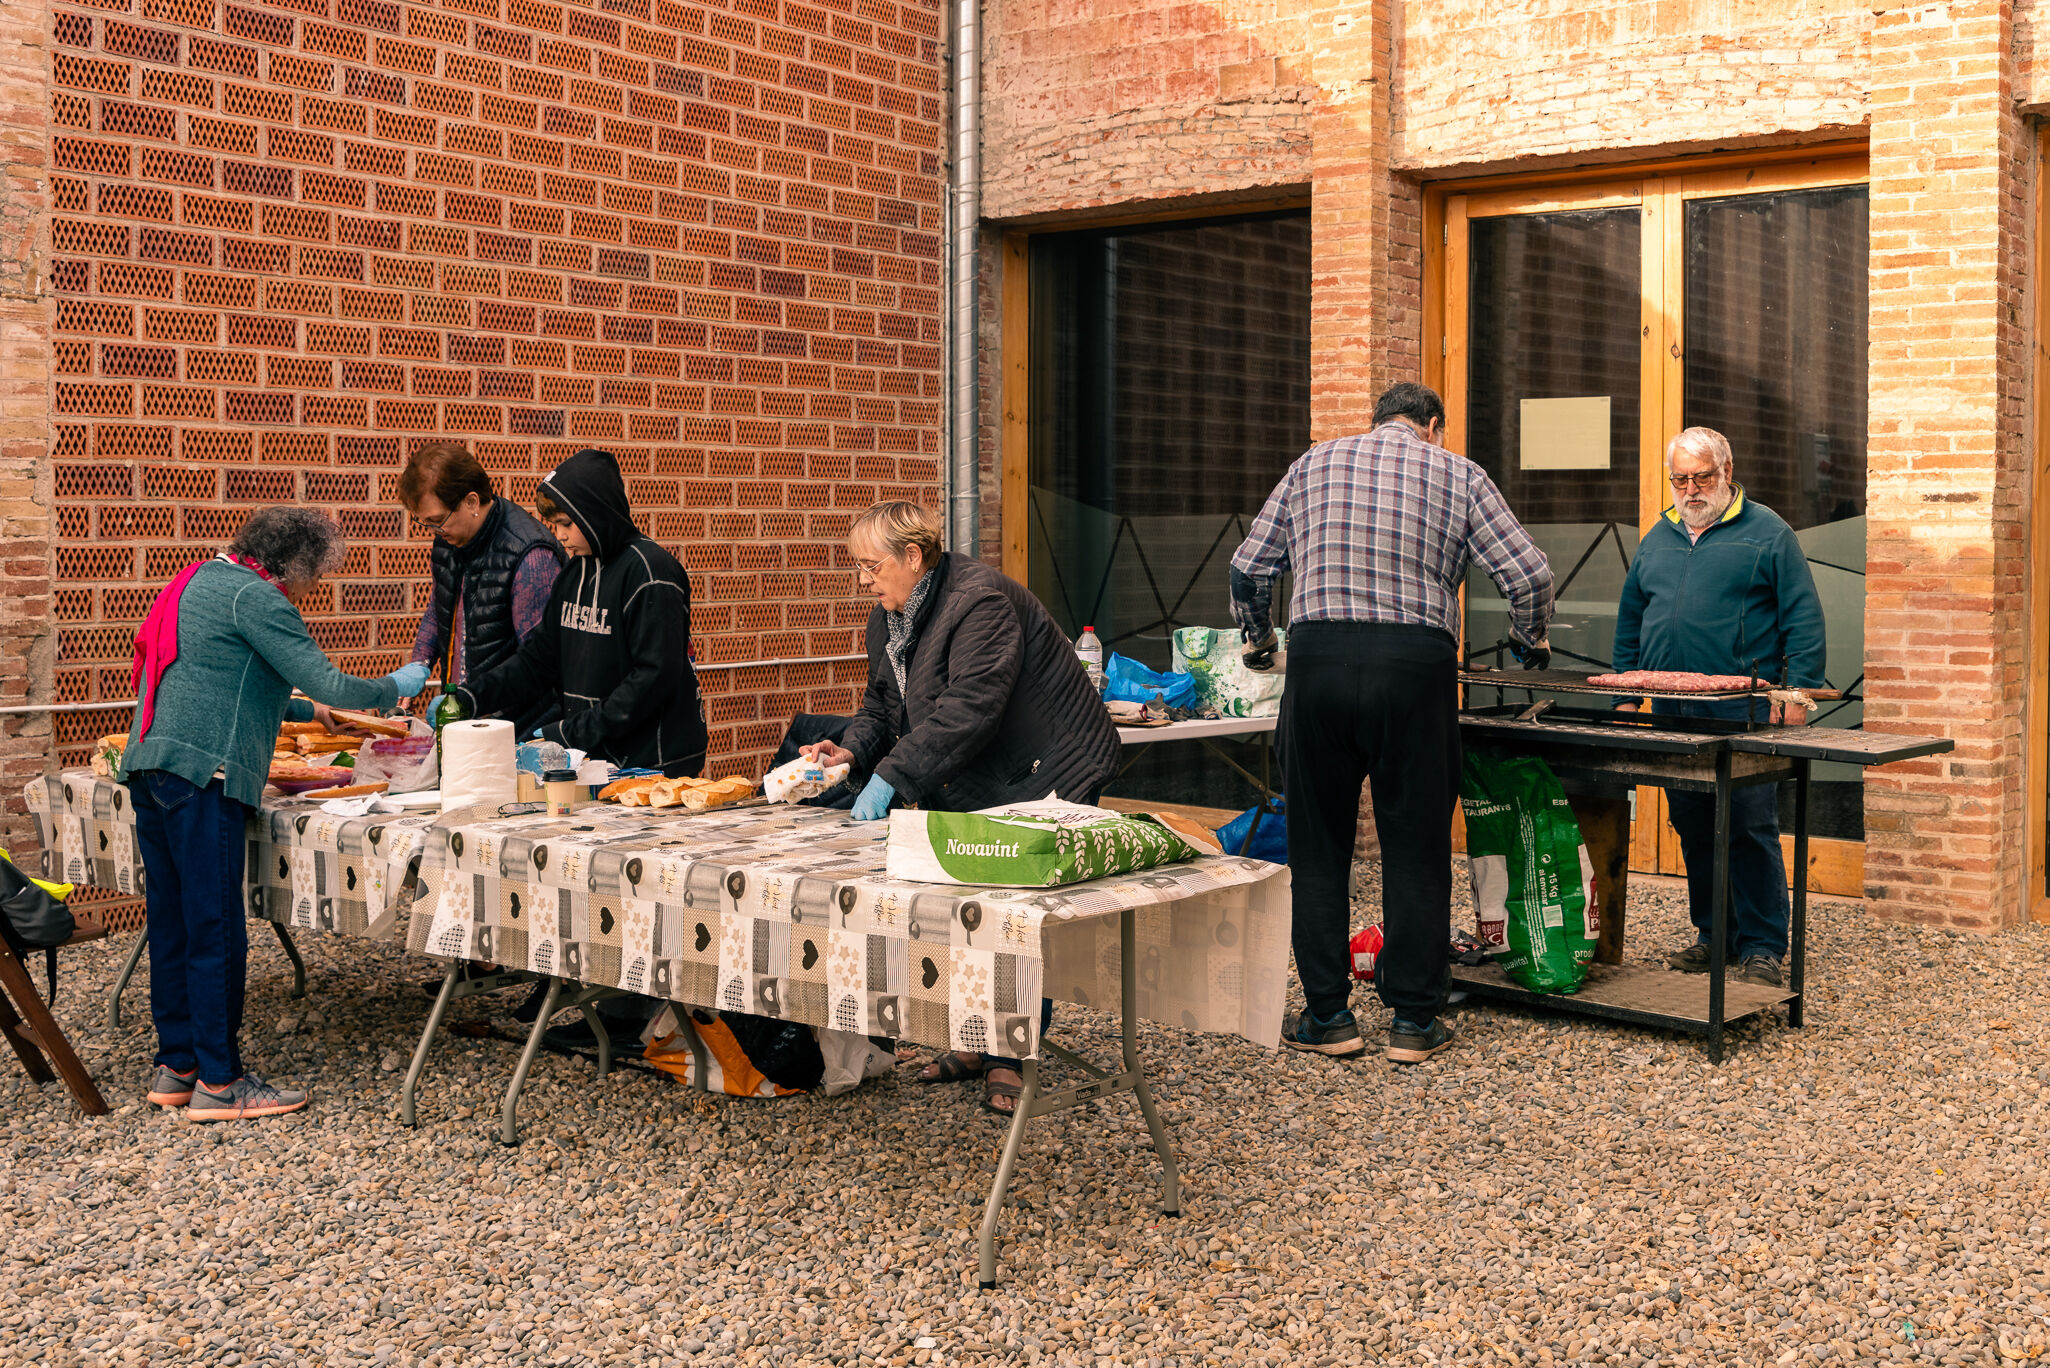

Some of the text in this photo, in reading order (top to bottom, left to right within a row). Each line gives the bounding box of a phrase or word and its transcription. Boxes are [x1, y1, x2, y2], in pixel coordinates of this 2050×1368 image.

[945, 838, 1020, 858] Novavint
[1549, 872, 1559, 898] 15 Kg
